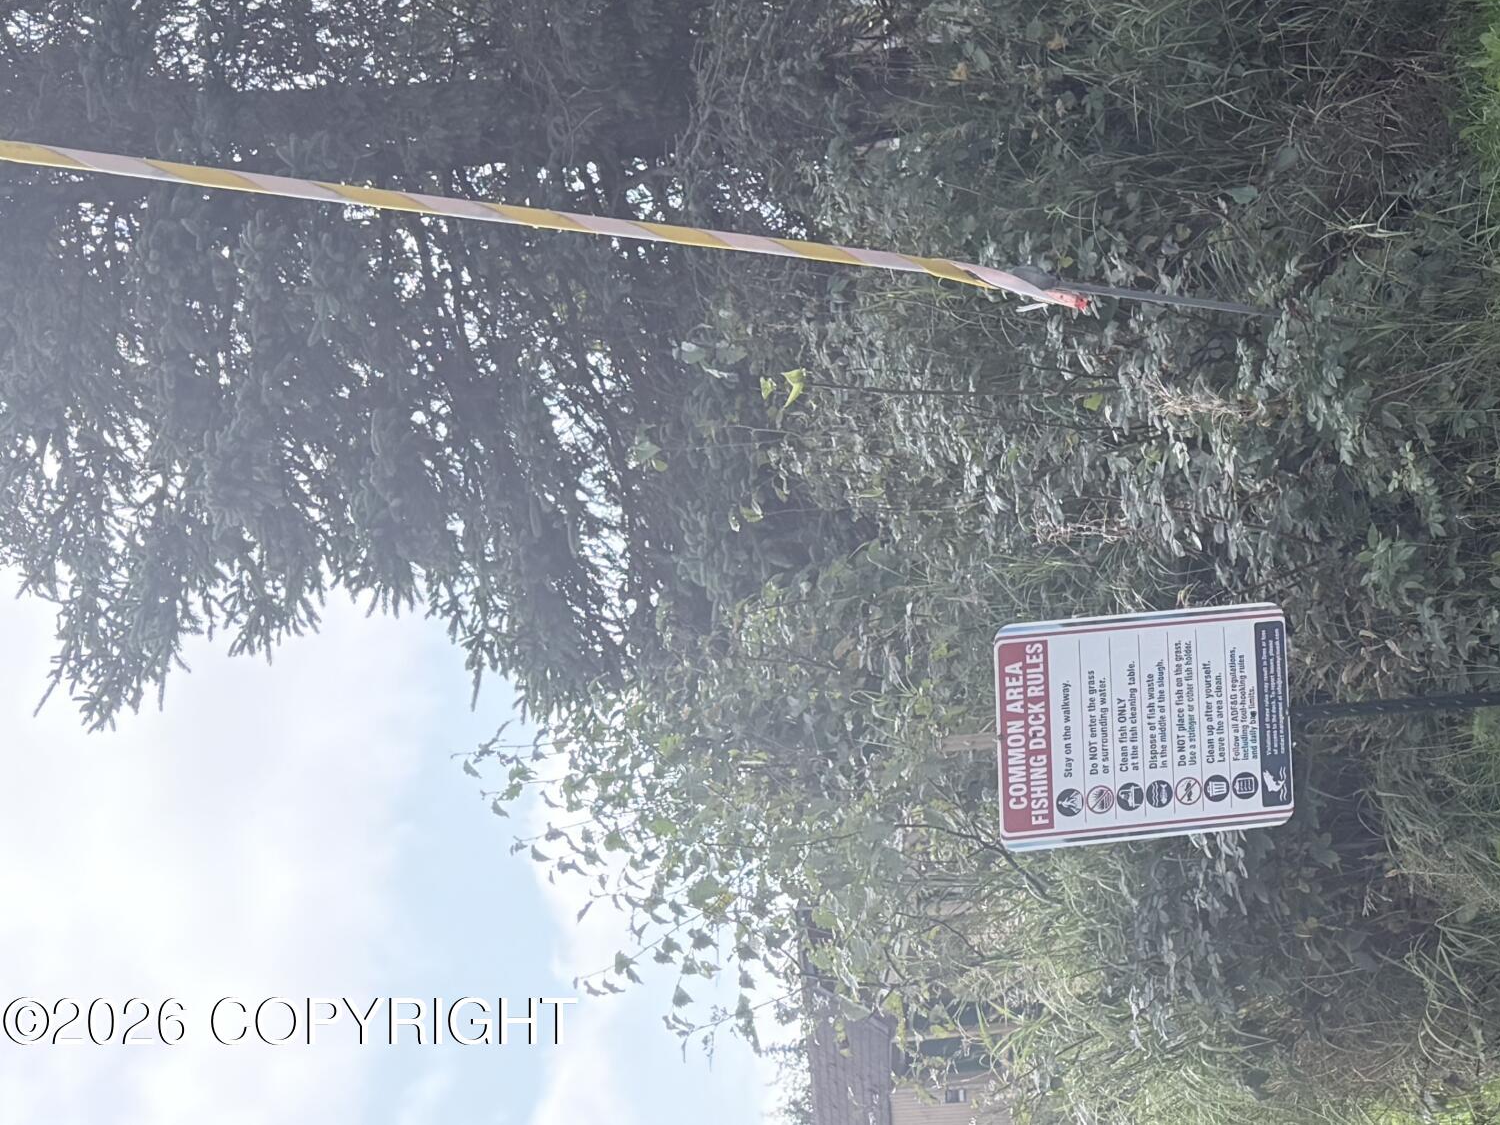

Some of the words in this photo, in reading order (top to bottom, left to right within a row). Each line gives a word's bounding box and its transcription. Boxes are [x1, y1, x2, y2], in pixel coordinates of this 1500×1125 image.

[1174, 640, 1183, 661] grass.
[1026, 643, 1044, 696] RULES
[1127, 661, 1135, 685] table.
[1156, 659, 1165, 687] slough.
[1174, 664, 1182, 675] the
[1185, 667, 1193, 681] fish
[1203, 661, 1213, 699] yourself.
[1005, 662, 1023, 713] AREA
[1087, 670, 1097, 694] grass
[1146, 674, 1154, 700] waste
[1176, 678, 1182, 687] on
[1061, 680, 1071, 723] walkway.
[1157, 690, 1165, 703] the
[1175, 690, 1183, 705] fish
[1186, 684, 1194, 702] other
[1117, 698, 1126, 723] ONLY
[1128, 688, 1137, 724] cleaning
[1147, 702, 1155, 719] fish
[1158, 705, 1165, 713] of
[1204, 701, 1212, 722] after
[1028, 701, 1046, 749] DOCK
[1147, 722, 1155, 731] of
[1158, 715, 1166, 742] middle
[1176, 708, 1187, 731] place
[1187, 714, 1197, 742] stringer
[1216, 721, 1224, 734] the
[1063, 726, 1071, 740] the
[1099, 708, 1109, 762] surrounding
[1118, 726, 1127, 743] fish
[1205, 725, 1215, 736] up
[1249, 727, 1258, 743] daily
[1064, 743, 1071, 754] on
[1089, 741, 1097, 760] NOT
[1149, 734, 1158, 769] Dispose
[1177, 734, 1186, 752] NOT
[1206, 739, 1214, 763] Clean
[1217, 737, 1225, 762] Leave
[1232, 736, 1240, 761] Follow
[1239, 725, 1249, 760] including
[1007, 720, 1027, 809] COMMON
[1064, 758, 1074, 777] Stay
[1090, 763, 1098, 775] Do
[1102, 764, 1109, 773] or
[1120, 746, 1128, 772] Clean
[1131, 762, 1139, 771] at
[1160, 760, 1167, 768] in
[1178, 755, 1186, 766] Do
[1031, 755, 1049, 825] FISHING
